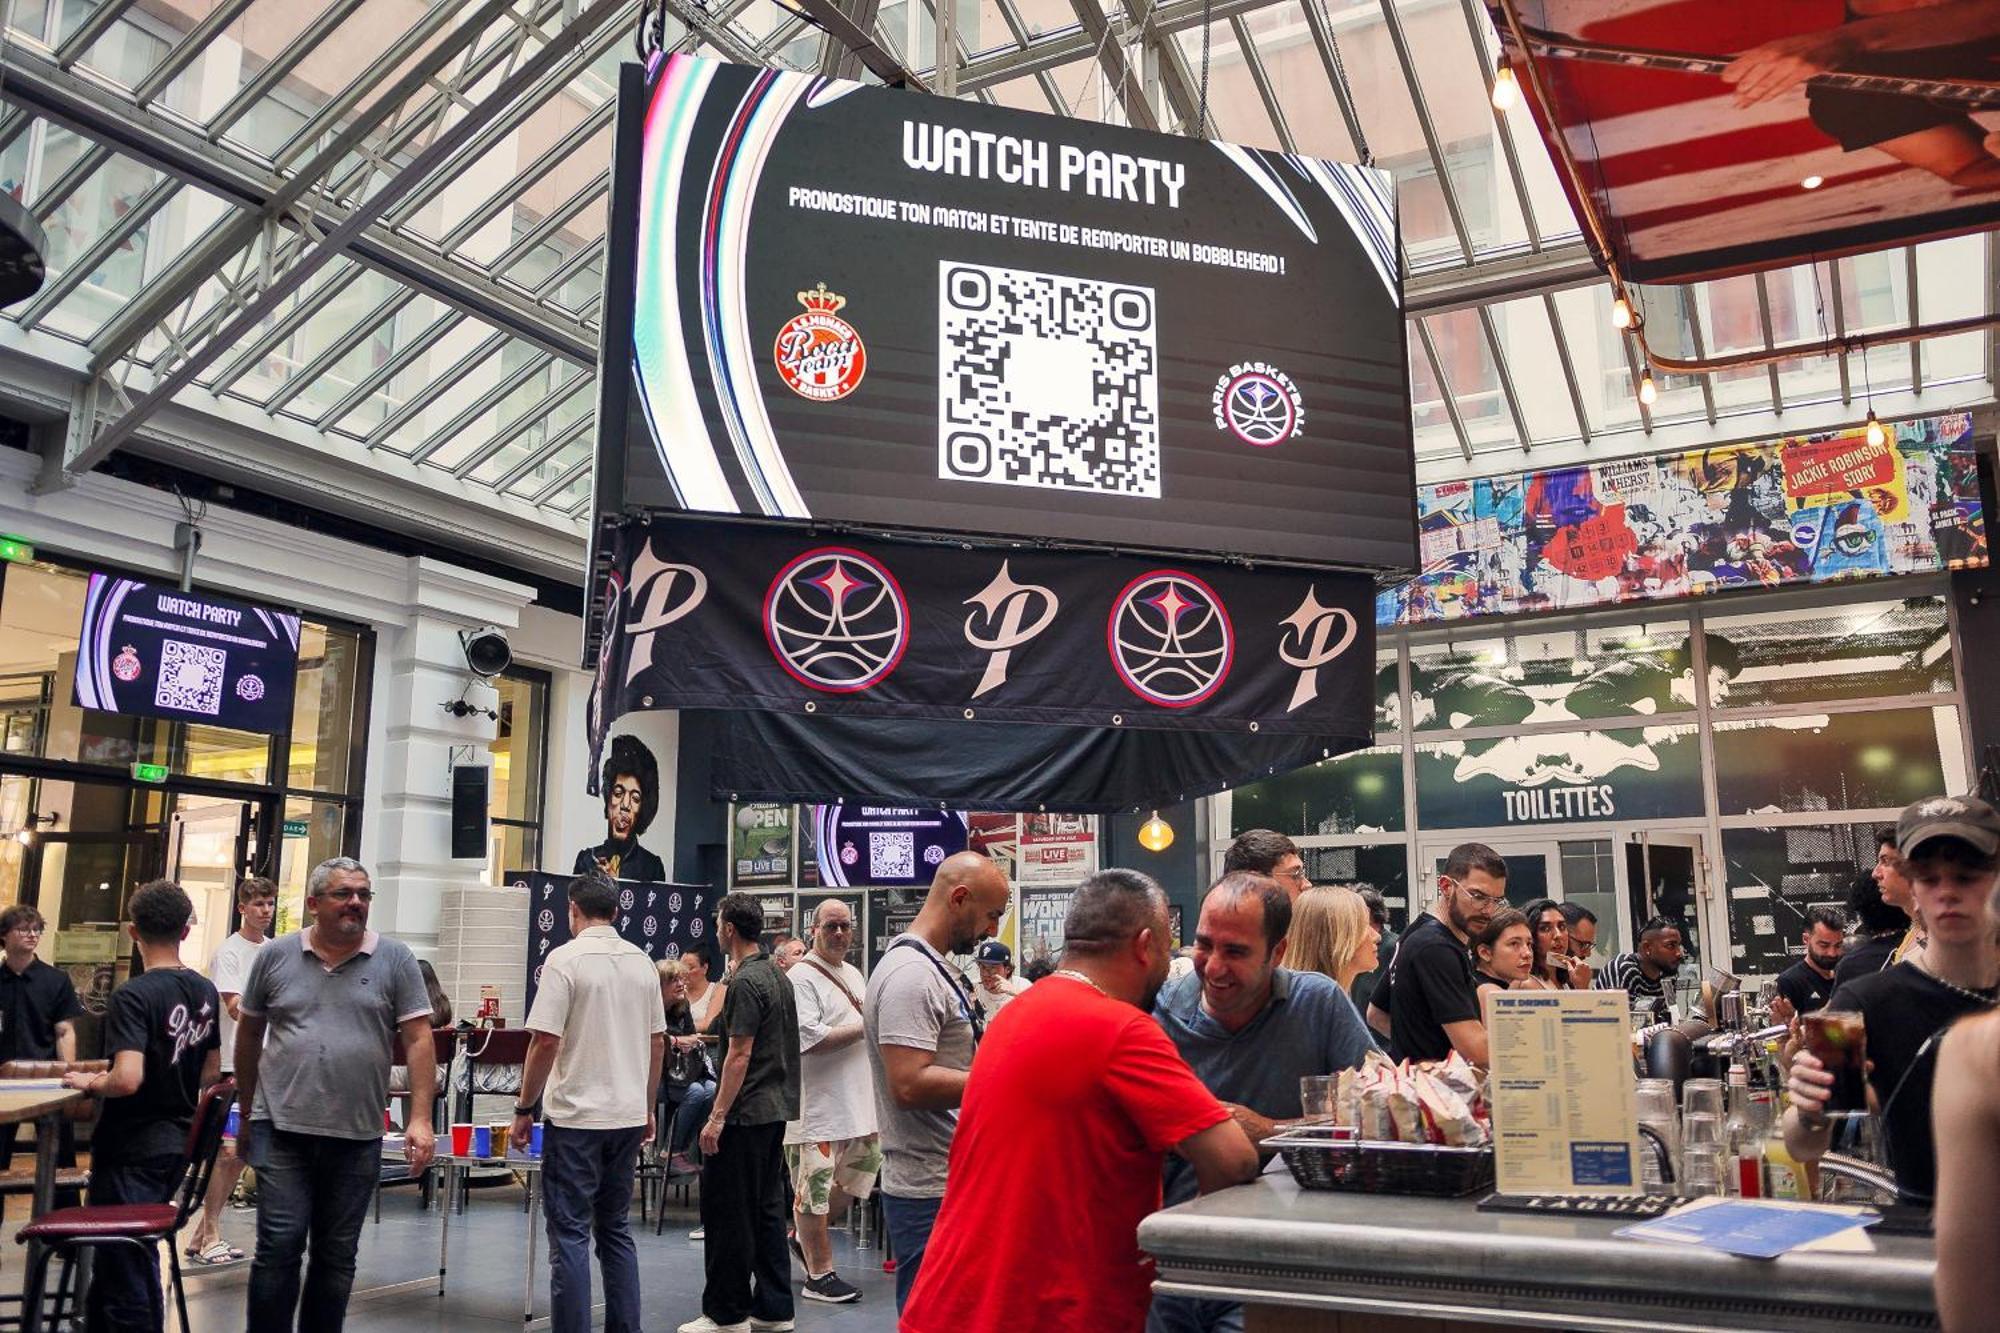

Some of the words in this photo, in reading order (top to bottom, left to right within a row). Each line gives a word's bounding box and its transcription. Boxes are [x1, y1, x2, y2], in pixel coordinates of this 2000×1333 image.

[903, 120, 1050, 189] WATCH
[1061, 144, 1186, 209] PARTY
[789, 187, 897, 221] PRONOSTIQUE
[899, 202, 931, 225] TON
[933, 206, 987, 233] MATCH
[991, 214, 1010, 236] ET
[1011, 217, 1058, 243] TENTE
[1059, 224, 1079, 246] DE
[1081, 227, 1169, 259] REMPORTER
[1171, 240, 1190, 261] UN
[1193, 243, 1278, 275] BOBBLEHEAD
[1212, 375, 1232, 430] PARIS
[1228, 361, 1305, 438] BASKETBALL
[1599, 458, 1650, 479] WILLIAMS
[1791, 463, 1829, 490] JACKIE
[1828, 444, 1888, 474] ROBINSON
[1802, 458, 1816, 467] THE
[1843, 463, 1877, 488] STORY
[157, 594, 201, 619] WATCH
[202, 604, 242, 628] PARTY
[1502, 785, 1616, 822] TOILETTES
[754, 859, 772, 871] LIVE
[1043, 849, 1066, 859] LIVE
[1496, 998, 1516, 1007] THE
[1518, 998, 1560, 1008] DRINKS
